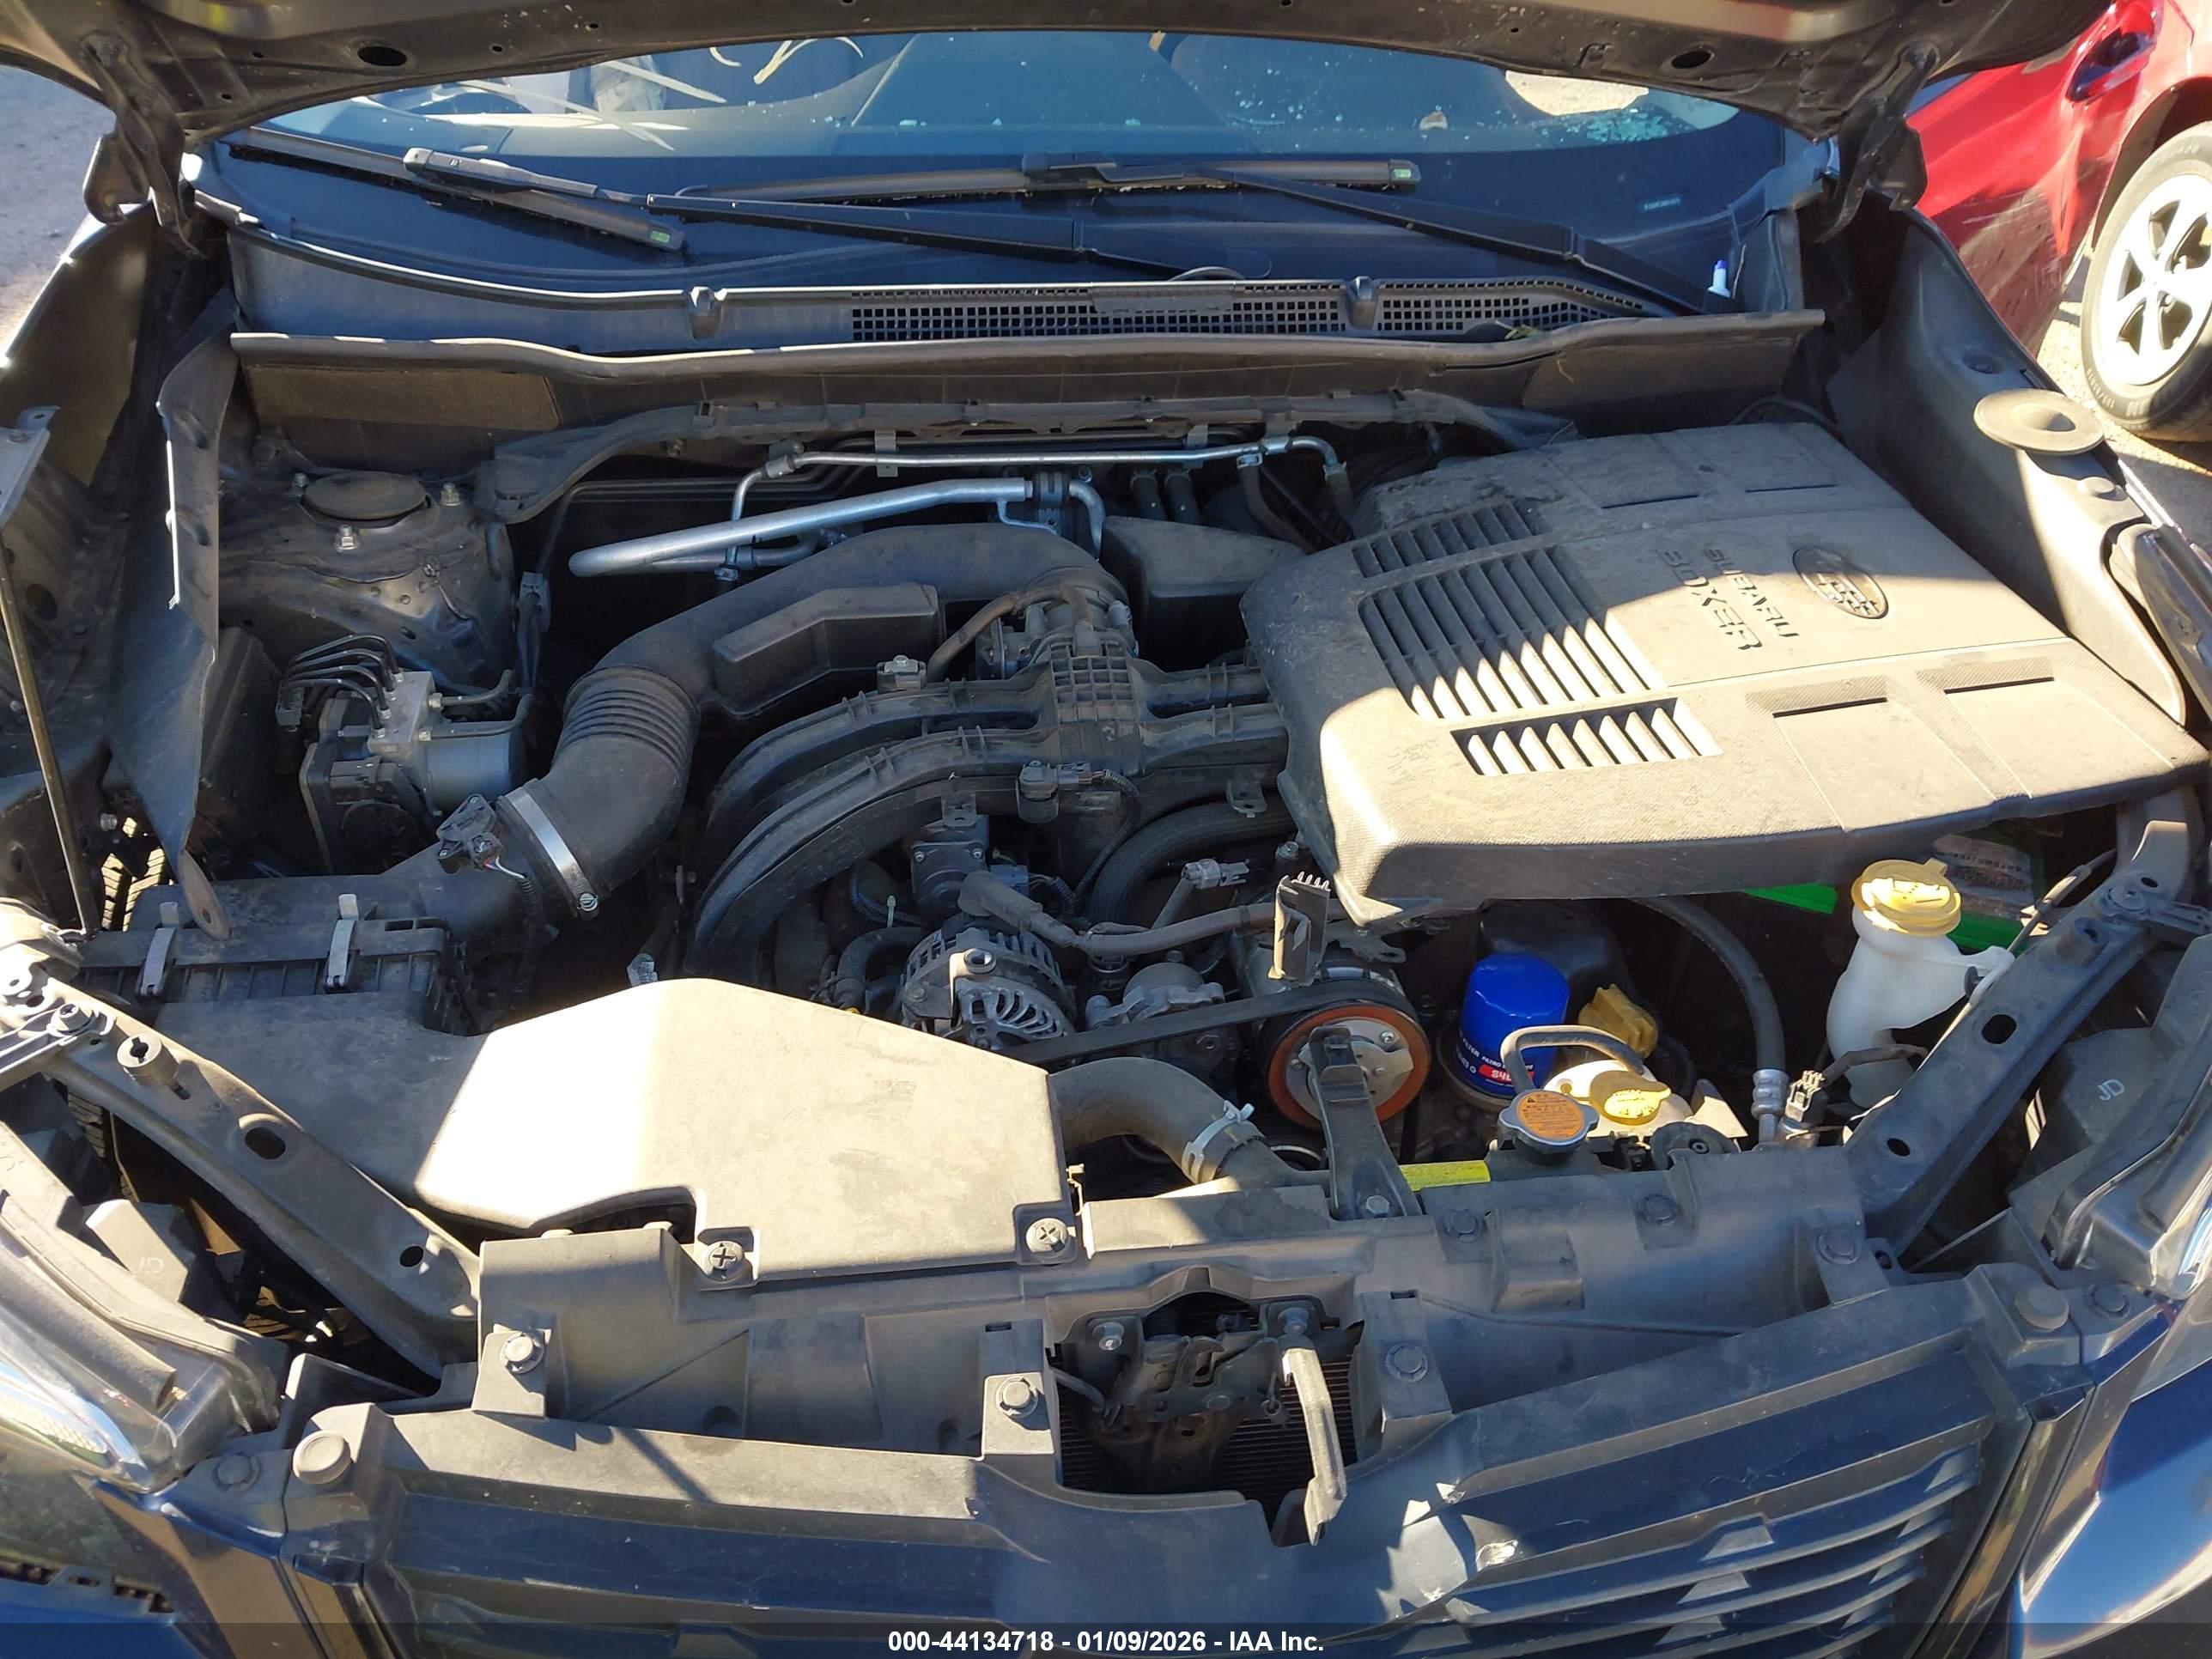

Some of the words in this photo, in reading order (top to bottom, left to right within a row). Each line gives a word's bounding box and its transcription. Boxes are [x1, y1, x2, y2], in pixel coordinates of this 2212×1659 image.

[1655, 548, 1763, 651] BOXER
[1702, 549, 1800, 638] SUBARU
[2097, 1079, 2125, 1101] JD
